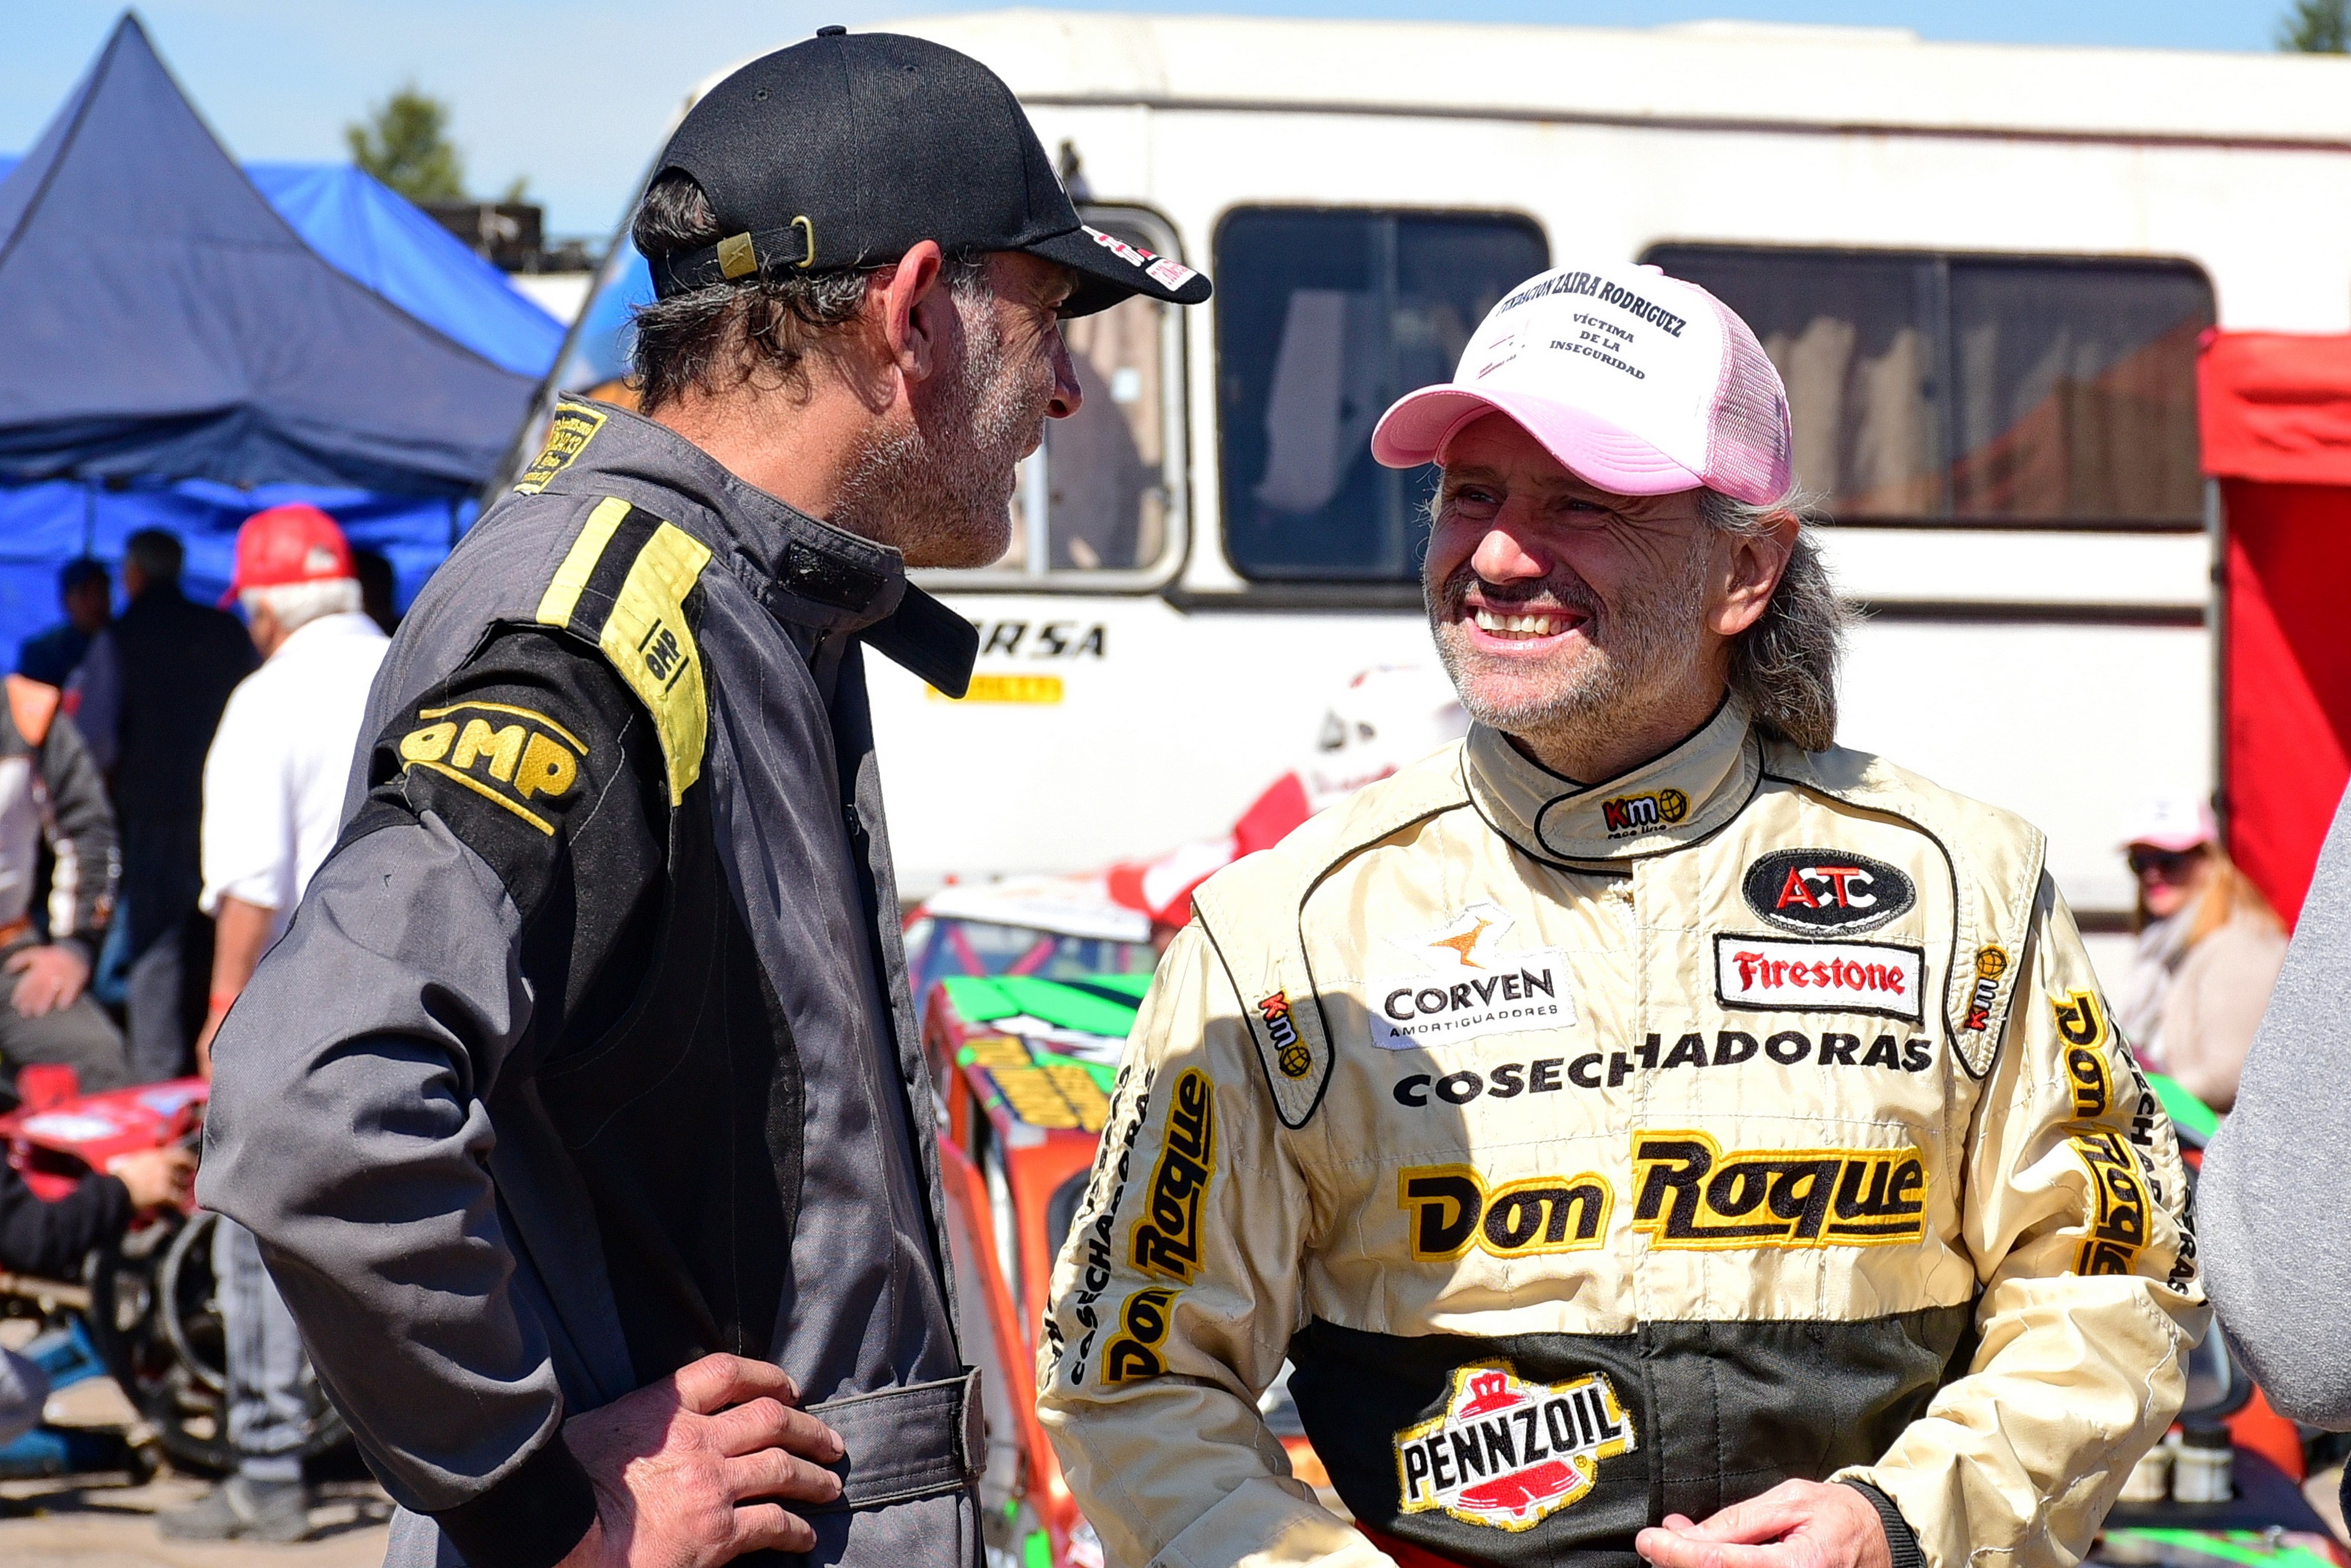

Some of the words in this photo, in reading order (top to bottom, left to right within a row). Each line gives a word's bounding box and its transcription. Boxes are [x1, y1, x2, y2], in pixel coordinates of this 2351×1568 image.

[1552, 271, 1603, 297] ZAIRA
[1598, 282, 1687, 339] RODRIGUEZ
[1573, 313, 1635, 343] VÍCTIMA
[1549, 340, 1646, 380] INSEGURIDAD
[1579, 330, 1600, 344] DE
[1602, 337, 1620, 353] LA
[645, 628, 682, 681] OMP
[972, 618, 1108, 658] RSA
[399, 718, 577, 800] OMP
[1384, 967, 1556, 1021] CORVEN
[1732, 950, 1905, 996] Firestone
[1389, 1004, 1559, 1038] AMORTIGUADORES
[1392, 1030, 1934, 1108] COSECHADORAS
[2057, 996, 2106, 1118] Don
[1133, 1072, 1215, 1278] Roque
[1407, 1174, 1605, 1253] Don
[1632, 1140, 1925, 1241] Roque
[1108, 1289, 1177, 1382] Don
[1404, 1386, 1622, 1500] PENNZOIL
